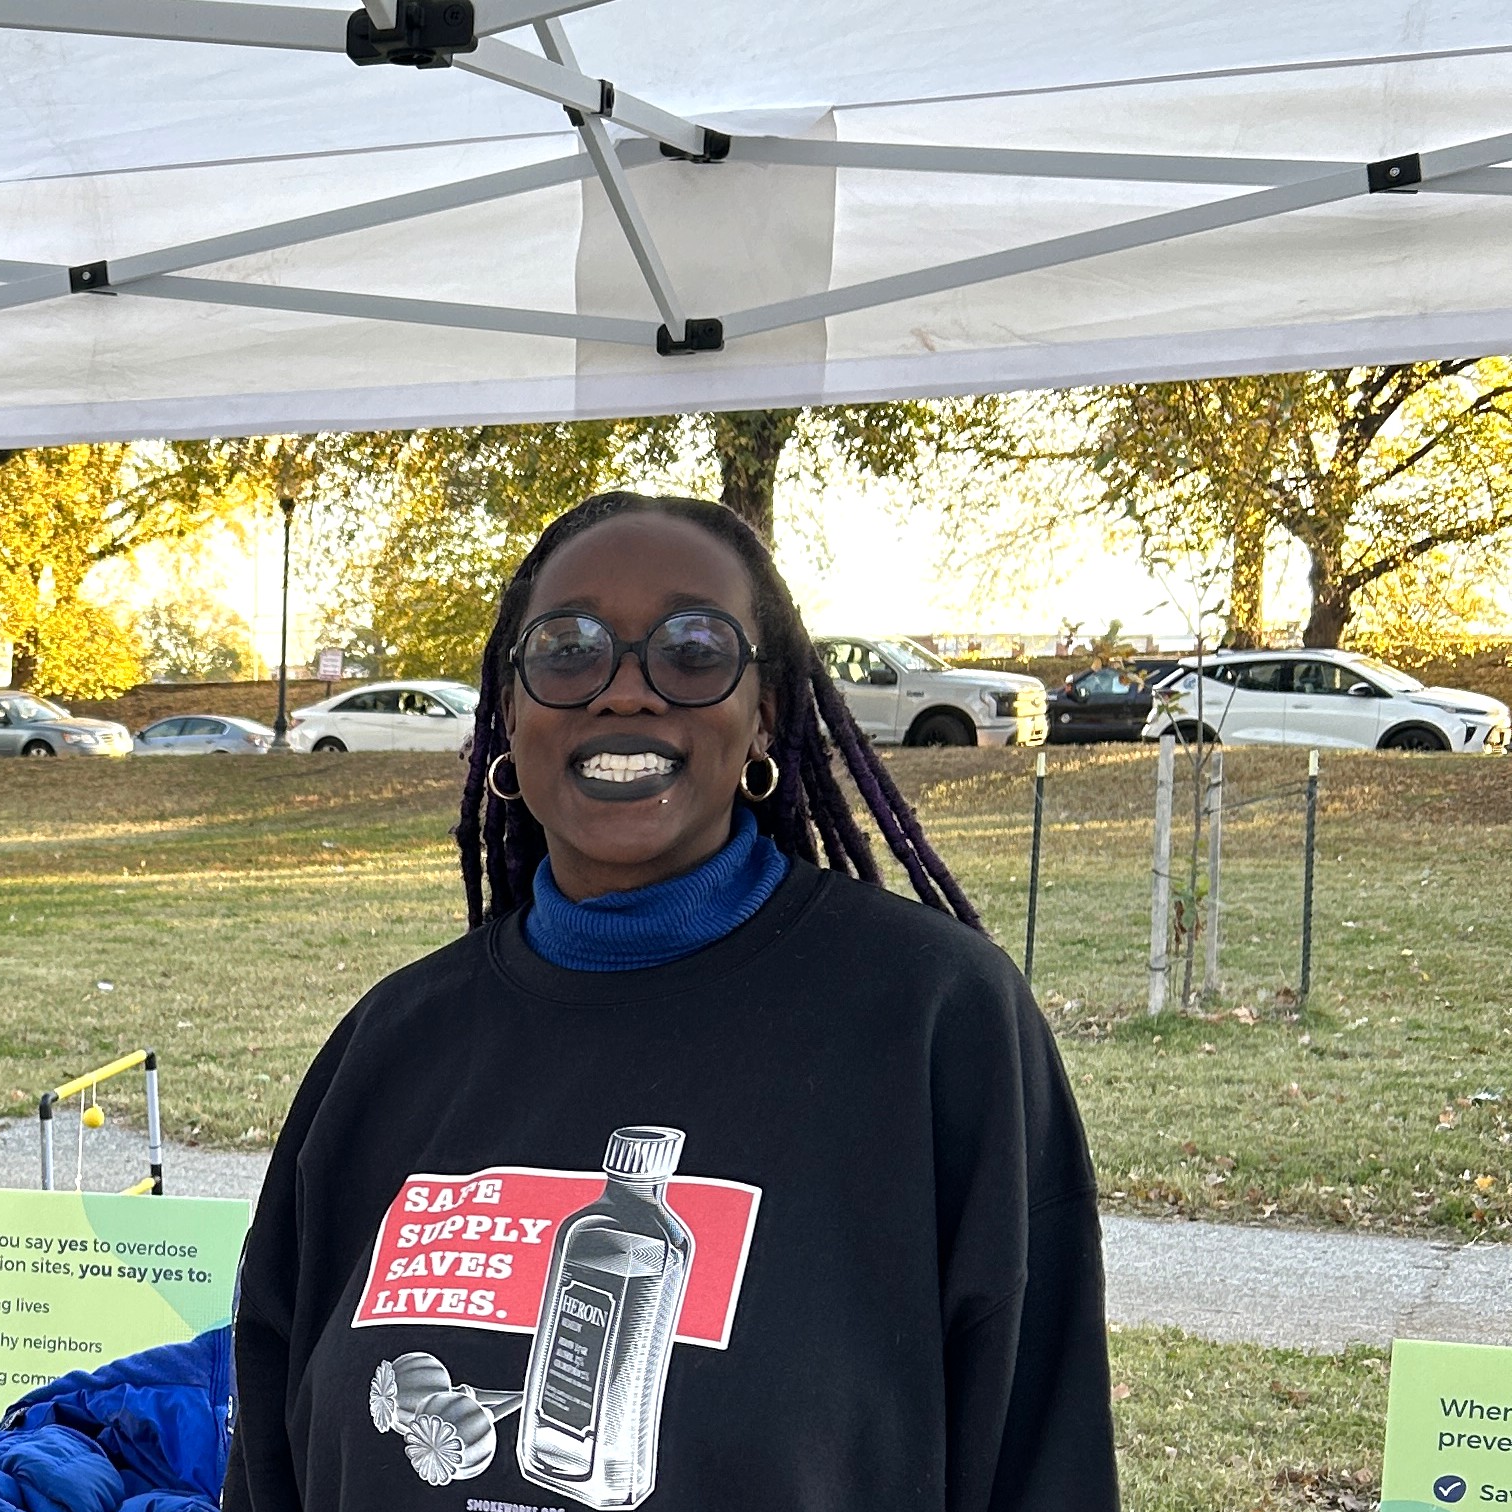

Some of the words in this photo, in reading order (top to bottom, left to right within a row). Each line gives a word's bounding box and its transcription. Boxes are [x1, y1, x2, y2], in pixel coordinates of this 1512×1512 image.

[404, 1179, 504, 1213] SAFE
[25, 1236, 54, 1253] say
[58, 1238, 88, 1255] yes
[93, 1237, 111, 1253] to
[115, 1240, 198, 1258] overdose
[396, 1214, 553, 1249] SUPPLY
[30, 1259, 75, 1277] sites,
[78, 1264, 112, 1280] you
[117, 1265, 148, 1283] say
[152, 1268, 183, 1285] yes
[188, 1267, 212, 1283] to:
[385, 1250, 514, 1282] SAVES
[16, 1296, 50, 1314] lives
[372, 1288, 508, 1319] LIVES.
[561, 1294, 608, 1328] HEROIN
[23, 1334, 102, 1353] neighbors
